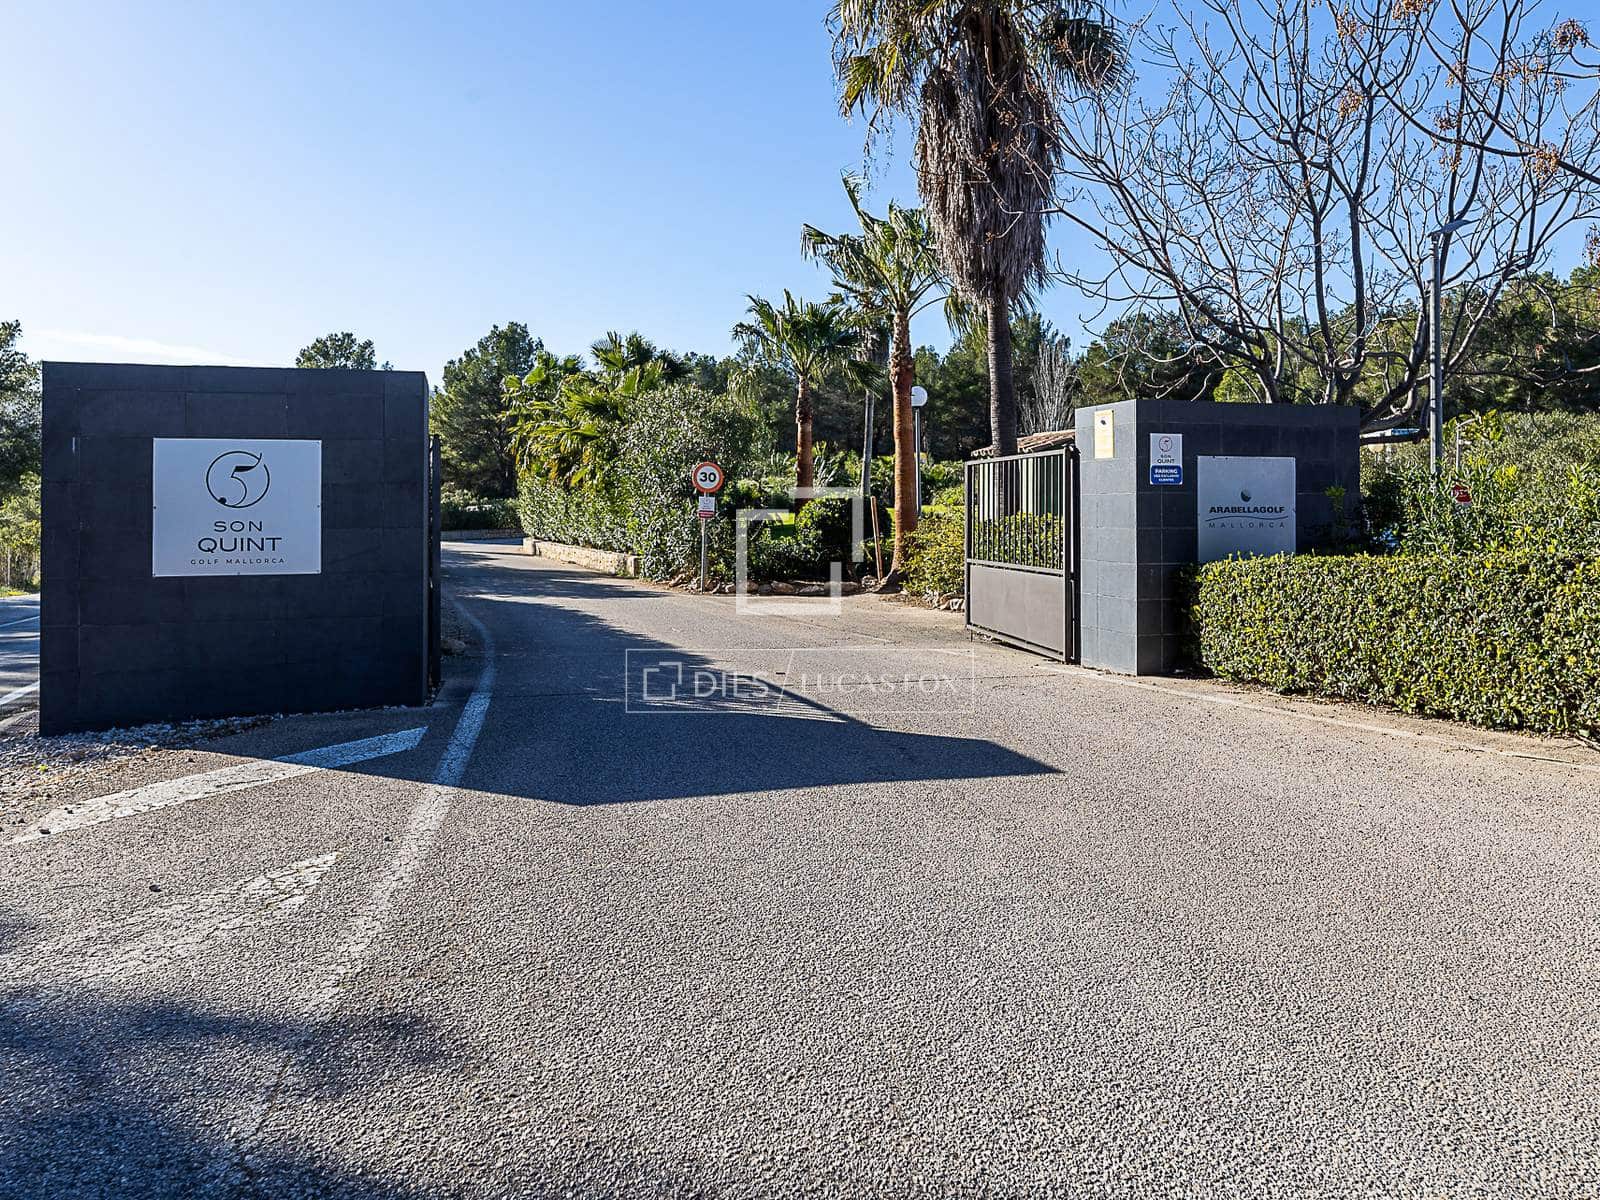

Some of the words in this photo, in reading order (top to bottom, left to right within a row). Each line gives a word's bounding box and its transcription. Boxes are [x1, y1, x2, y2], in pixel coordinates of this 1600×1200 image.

[700, 472, 717, 482] 30
[213, 520, 263, 533] SON
[197, 537, 283, 553] QUINT
